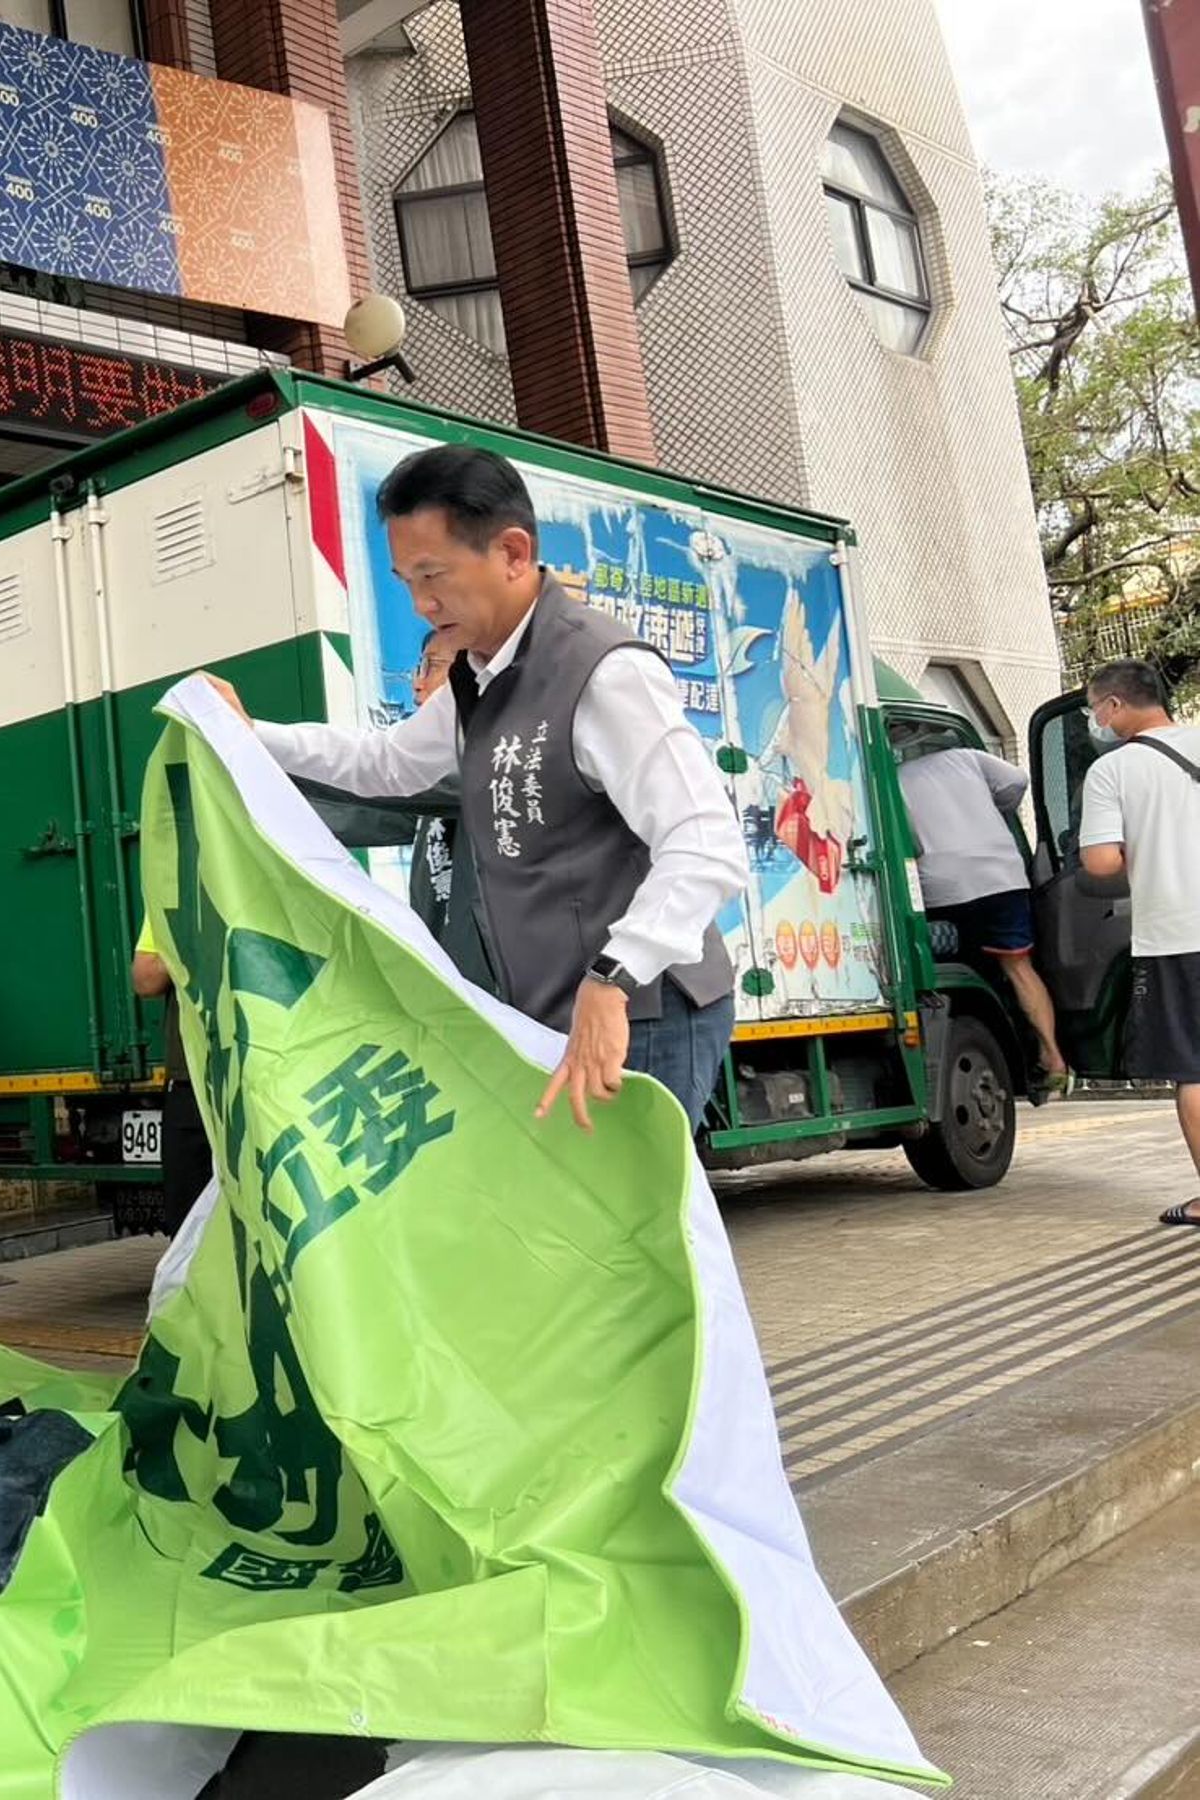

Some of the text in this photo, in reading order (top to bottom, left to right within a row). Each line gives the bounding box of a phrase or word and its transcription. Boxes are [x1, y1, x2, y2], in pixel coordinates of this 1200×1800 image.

[70, 110, 99, 128] 400
[146, 130, 172, 147] 400
[5, 182, 36, 201] 400
[84, 201, 113, 219] 400
[159, 219, 186, 236] 400
[520, 720, 549, 825] 立法委員
[488, 734, 522, 857] 林俊憲
[123, 1121, 163, 1153] 948
